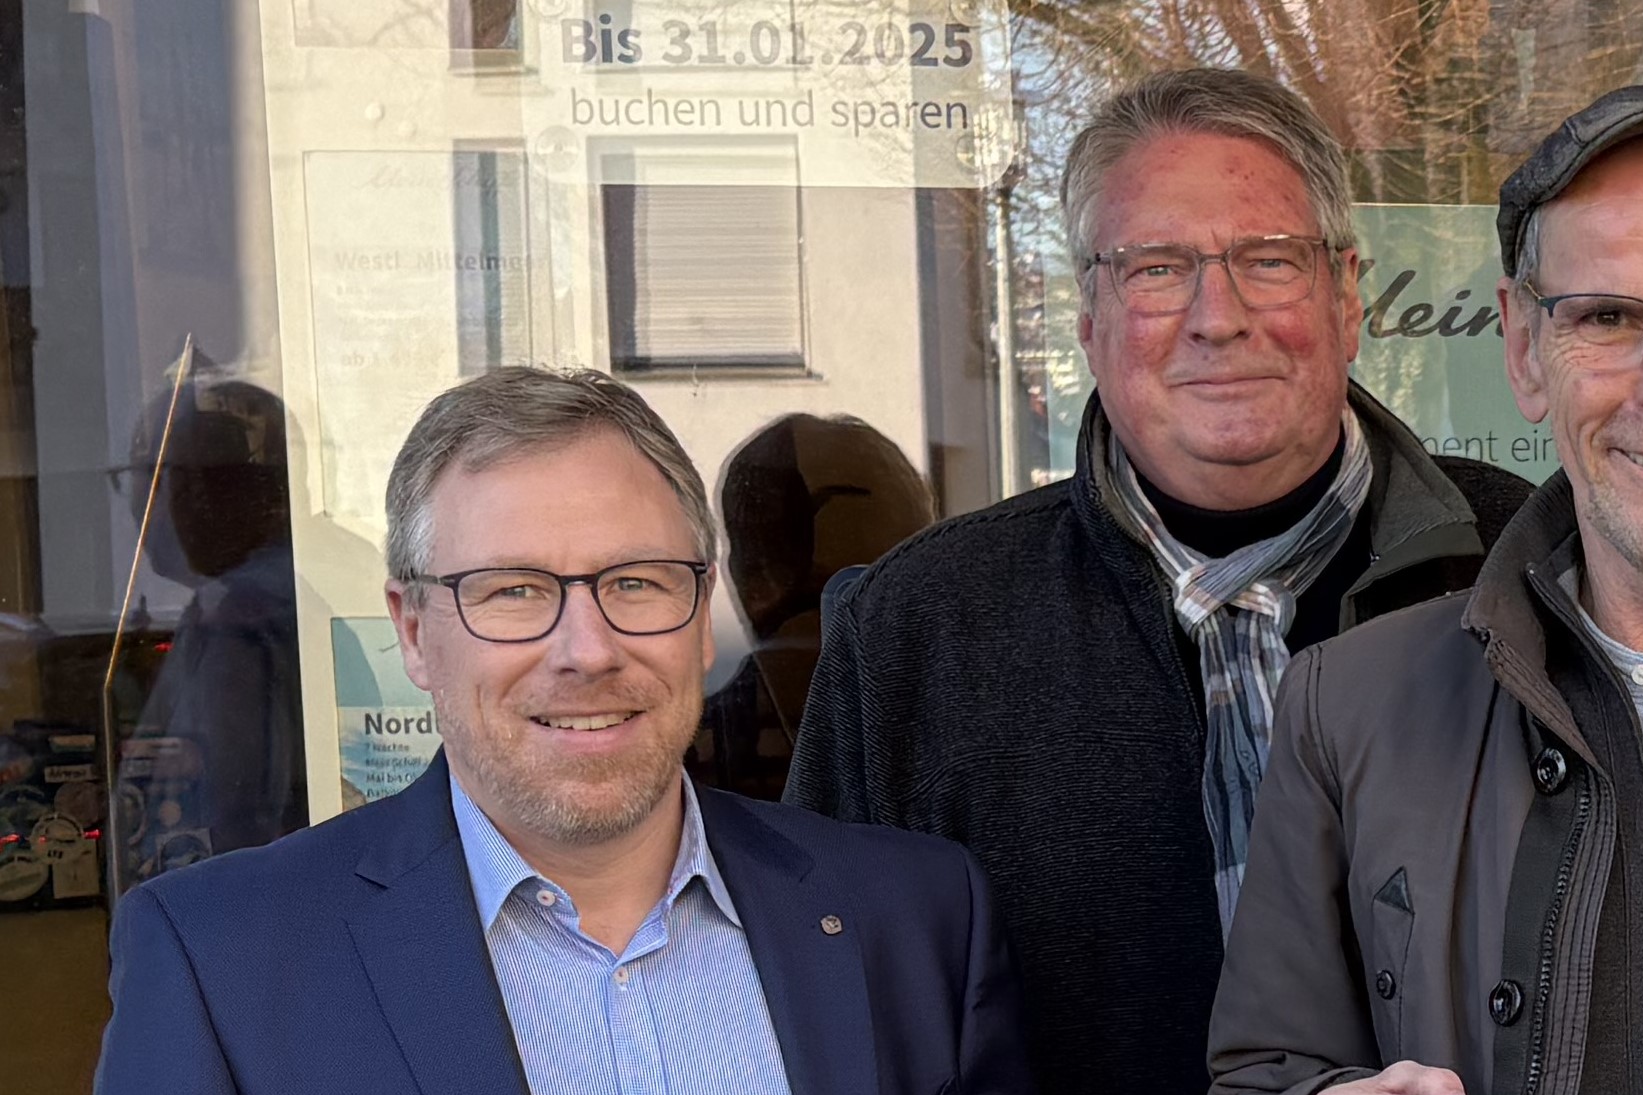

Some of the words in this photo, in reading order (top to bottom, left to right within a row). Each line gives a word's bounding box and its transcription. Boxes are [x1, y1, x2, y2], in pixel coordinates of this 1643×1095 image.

[560, 14, 643, 65] Bis
[660, 18, 974, 69] 31.01.2025
[571, 88, 722, 127] buchen
[738, 89, 815, 128] und
[831, 98, 969, 137] sparen
